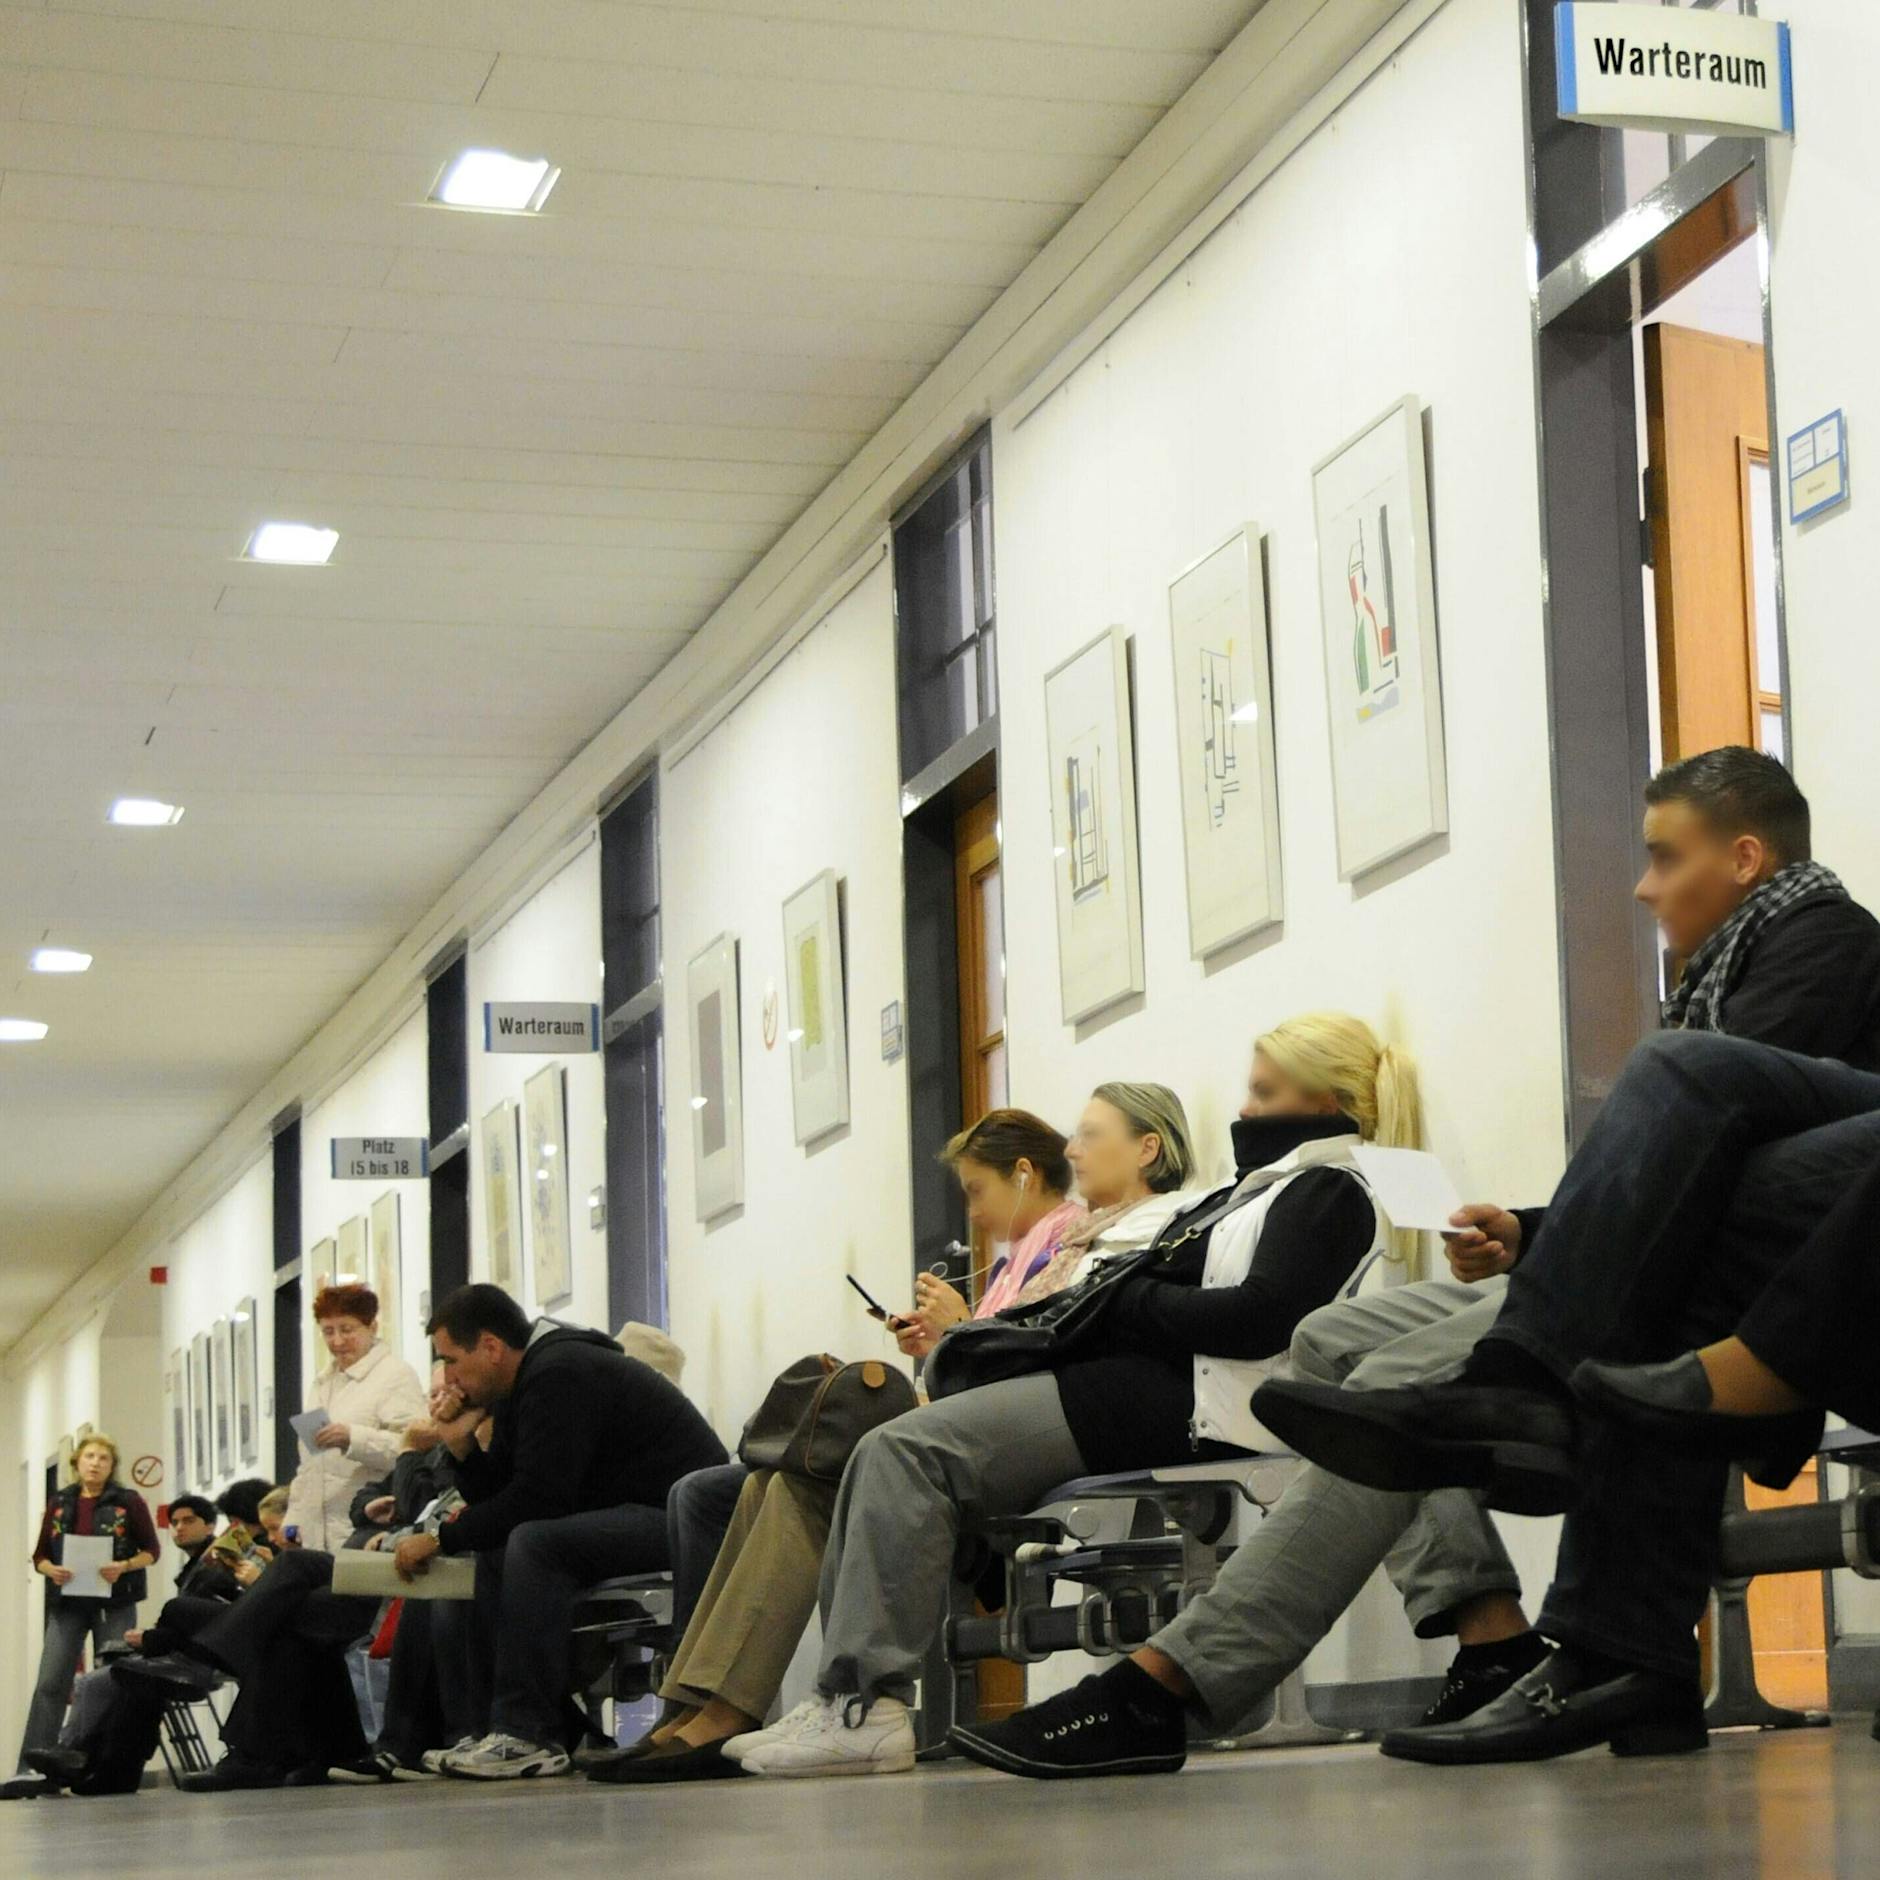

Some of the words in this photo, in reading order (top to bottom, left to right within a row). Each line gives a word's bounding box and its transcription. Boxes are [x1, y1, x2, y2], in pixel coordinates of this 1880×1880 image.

[1594, 38, 1767, 89] Warteraum
[499, 1016, 585, 1035] Warteraum
[362, 1139, 395, 1154] Platz
[369, 1160, 388, 1175] bis
[394, 1160, 409, 1175] 18
